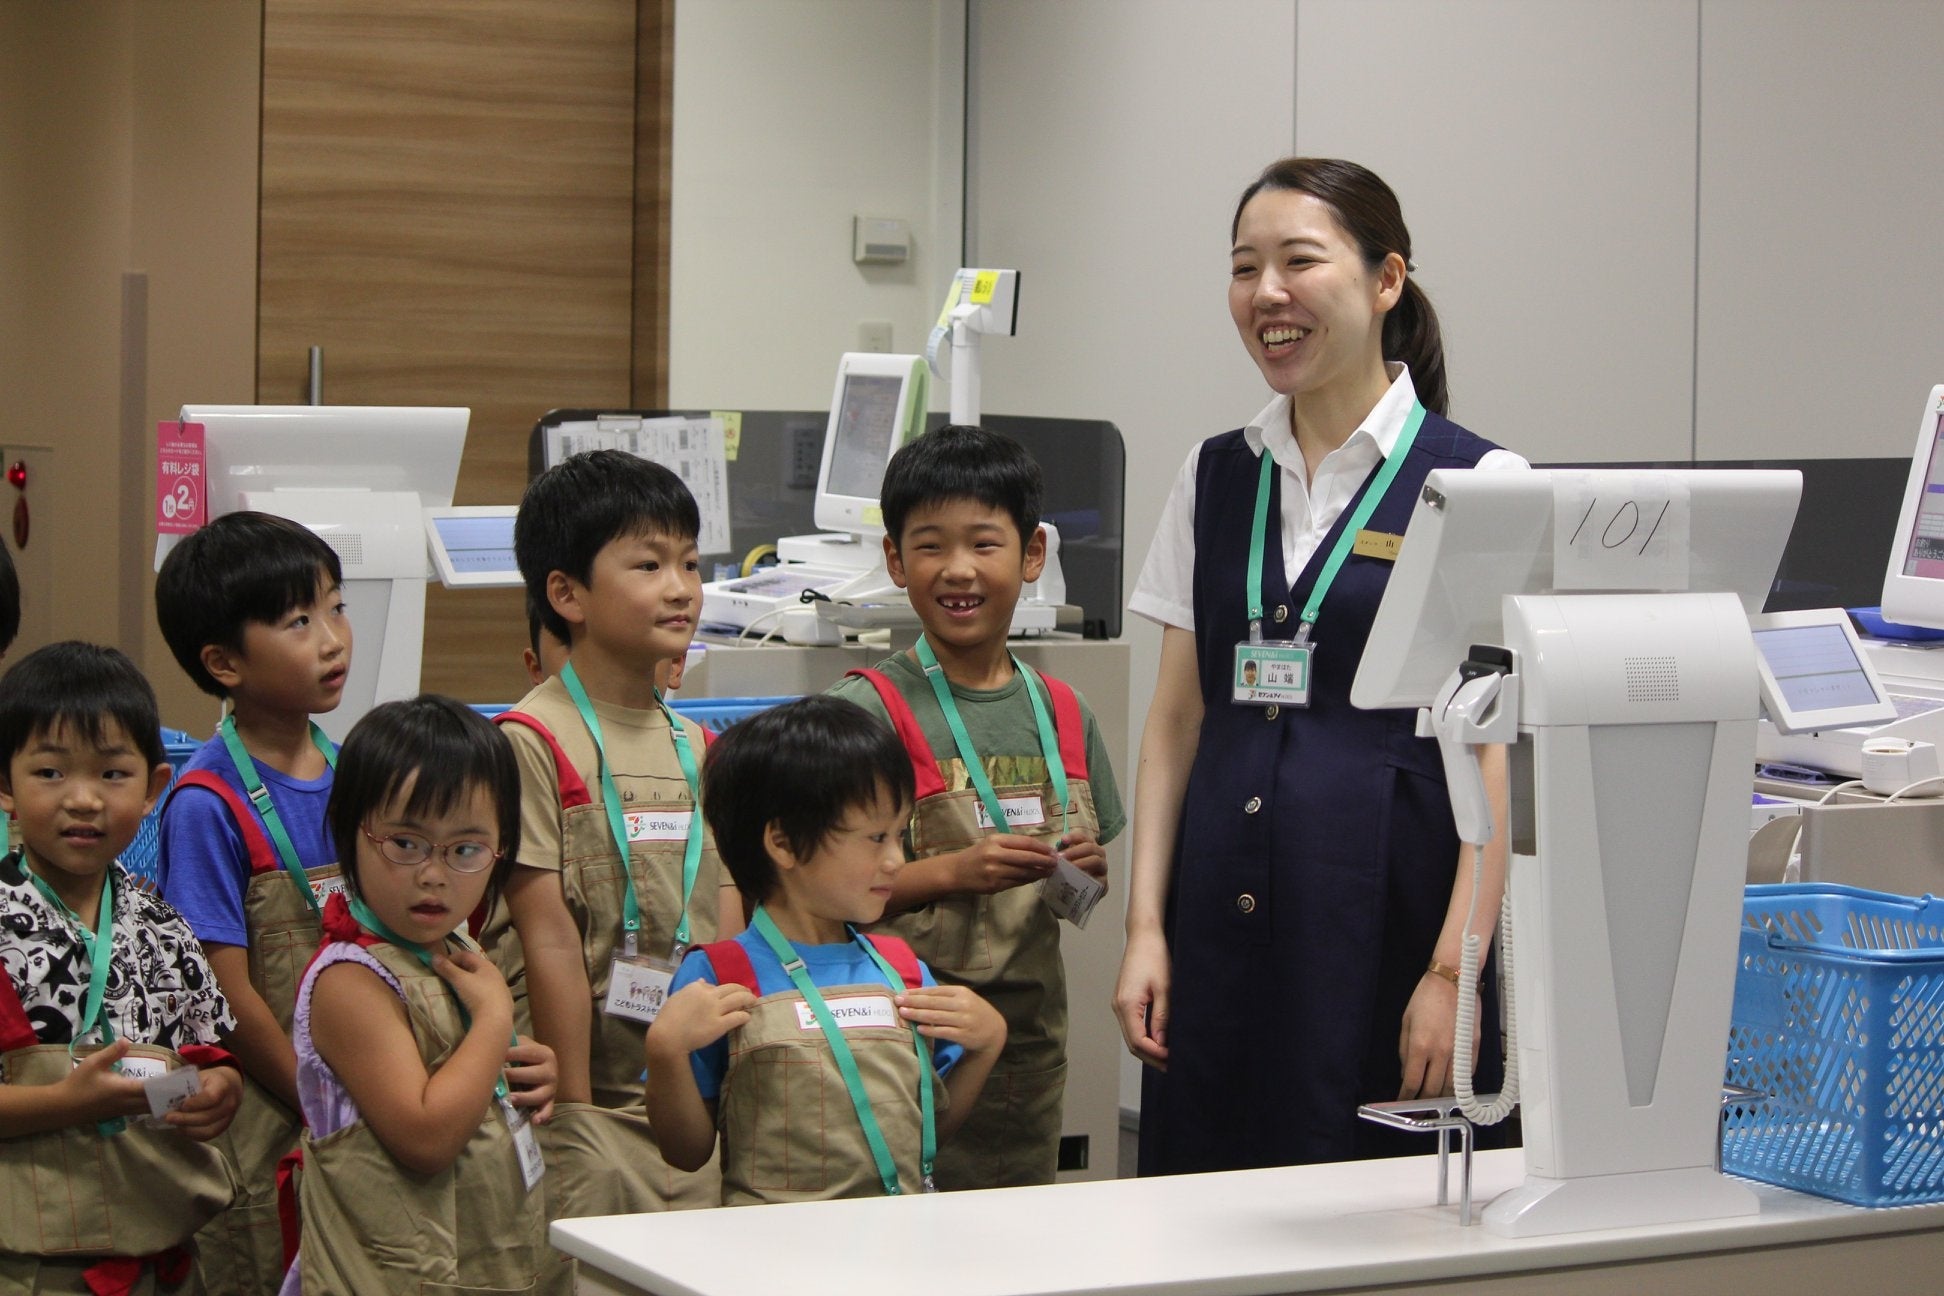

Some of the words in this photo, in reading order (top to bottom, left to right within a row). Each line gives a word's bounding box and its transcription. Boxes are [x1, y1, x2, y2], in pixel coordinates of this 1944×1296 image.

[162, 462, 200, 476] 有料レジ袋
[1569, 497, 1670, 556] 101
[649, 821, 678, 831] SEVEN&i
[830, 1007, 872, 1019] SEVEN&i
